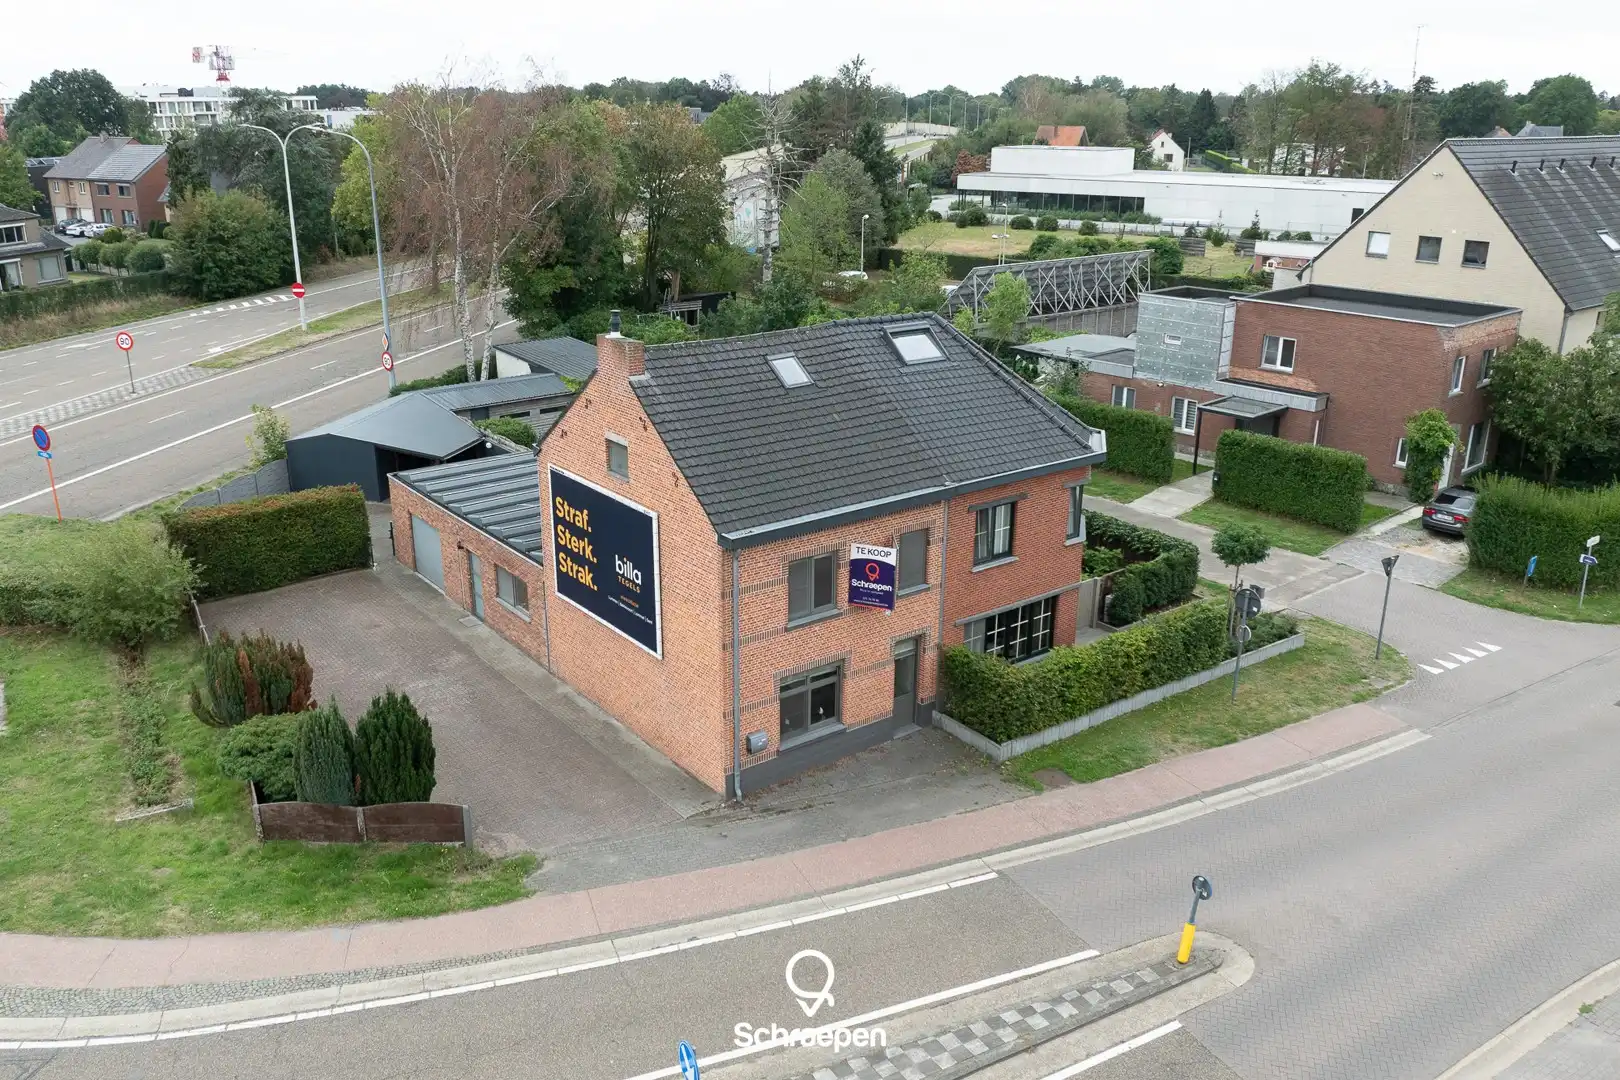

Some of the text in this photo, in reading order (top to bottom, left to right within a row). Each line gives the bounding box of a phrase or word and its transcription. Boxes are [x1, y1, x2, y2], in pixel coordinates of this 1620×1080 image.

[120, 337, 129, 345] 90
[555, 496, 592, 533] Straf.
[557, 524, 597, 564] Sterk.
[856, 546, 891, 557] TE KOOP
[558, 552, 598, 591] Strak.
[615, 554, 642, 586] billa
[617, 575, 641, 594] TEGELS
[851, 578, 893, 592] Schraepen
